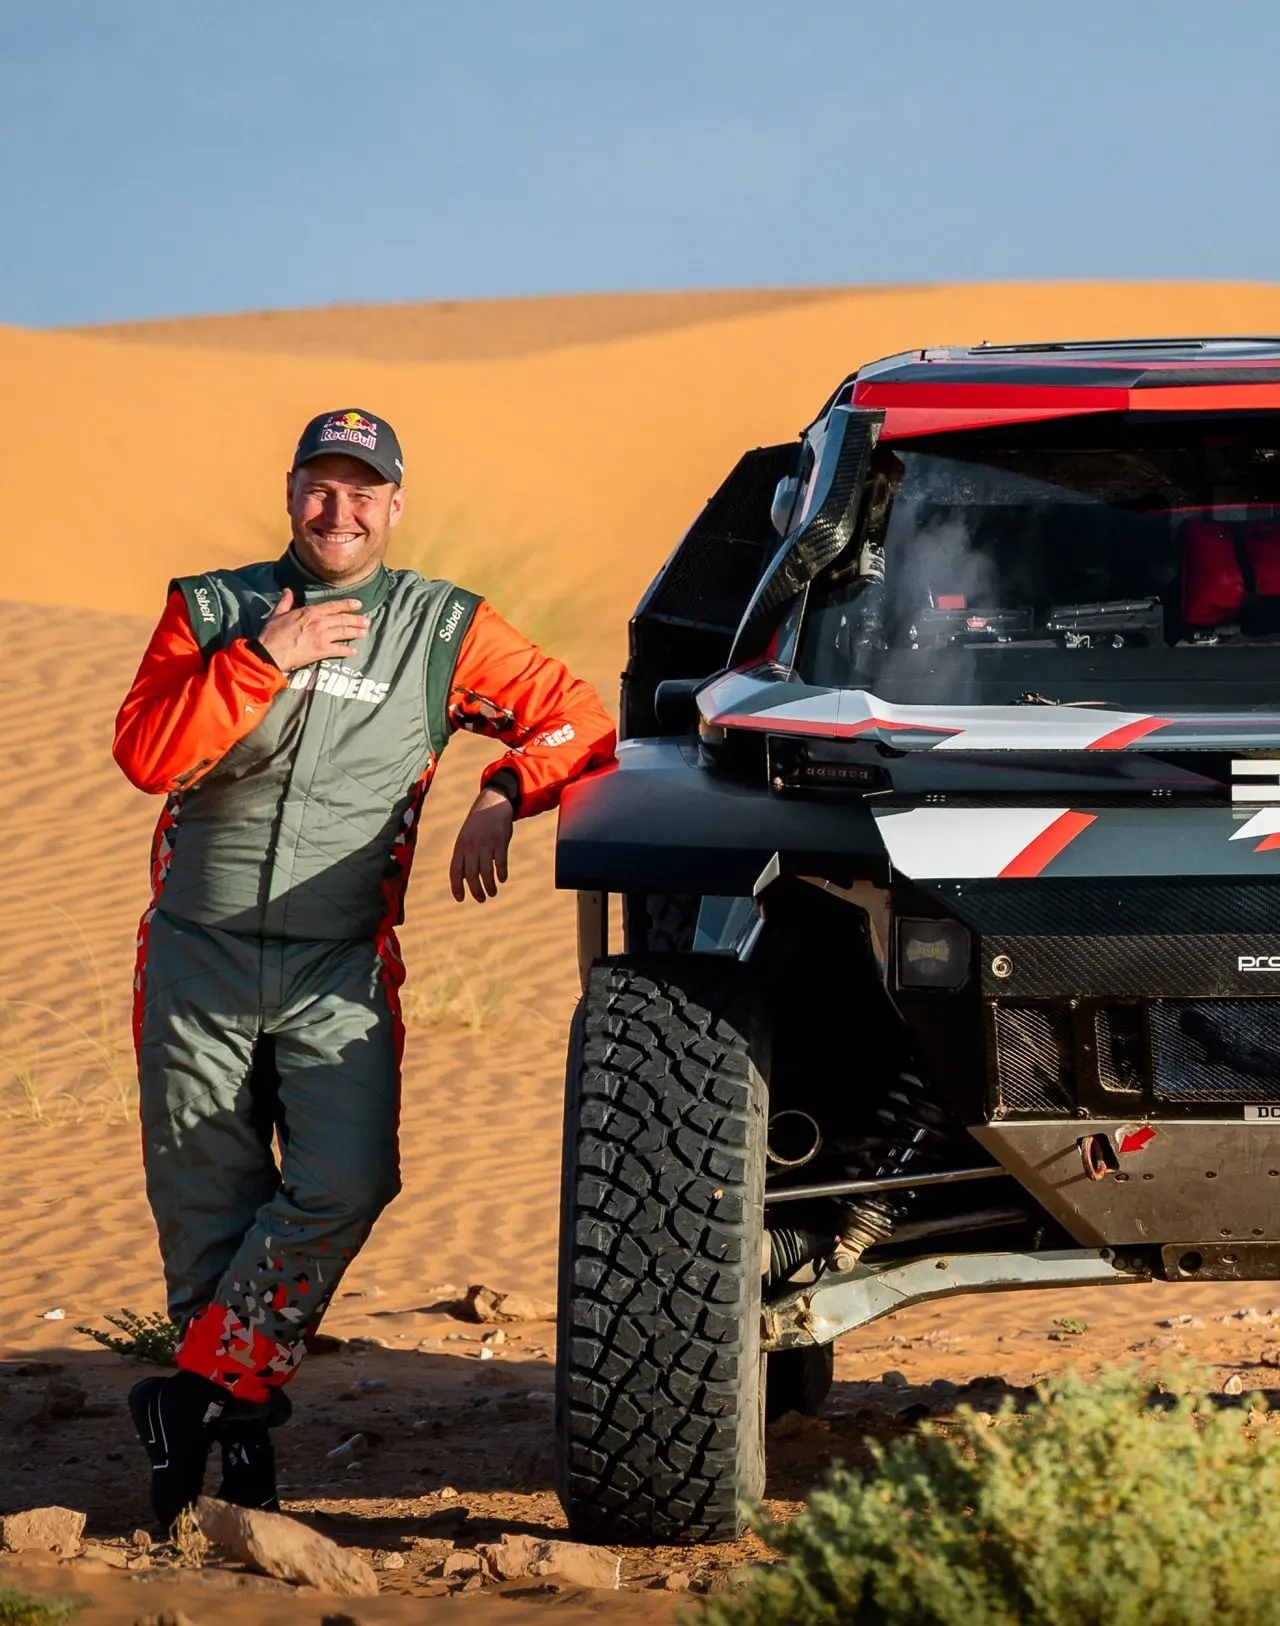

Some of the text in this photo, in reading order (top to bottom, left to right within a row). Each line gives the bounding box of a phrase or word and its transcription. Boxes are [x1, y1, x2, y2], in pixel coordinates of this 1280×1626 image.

[321, 428, 377, 450] Red Bull
[193, 587, 216, 624] Sabelt
[439, 602, 465, 642] Sabelt
